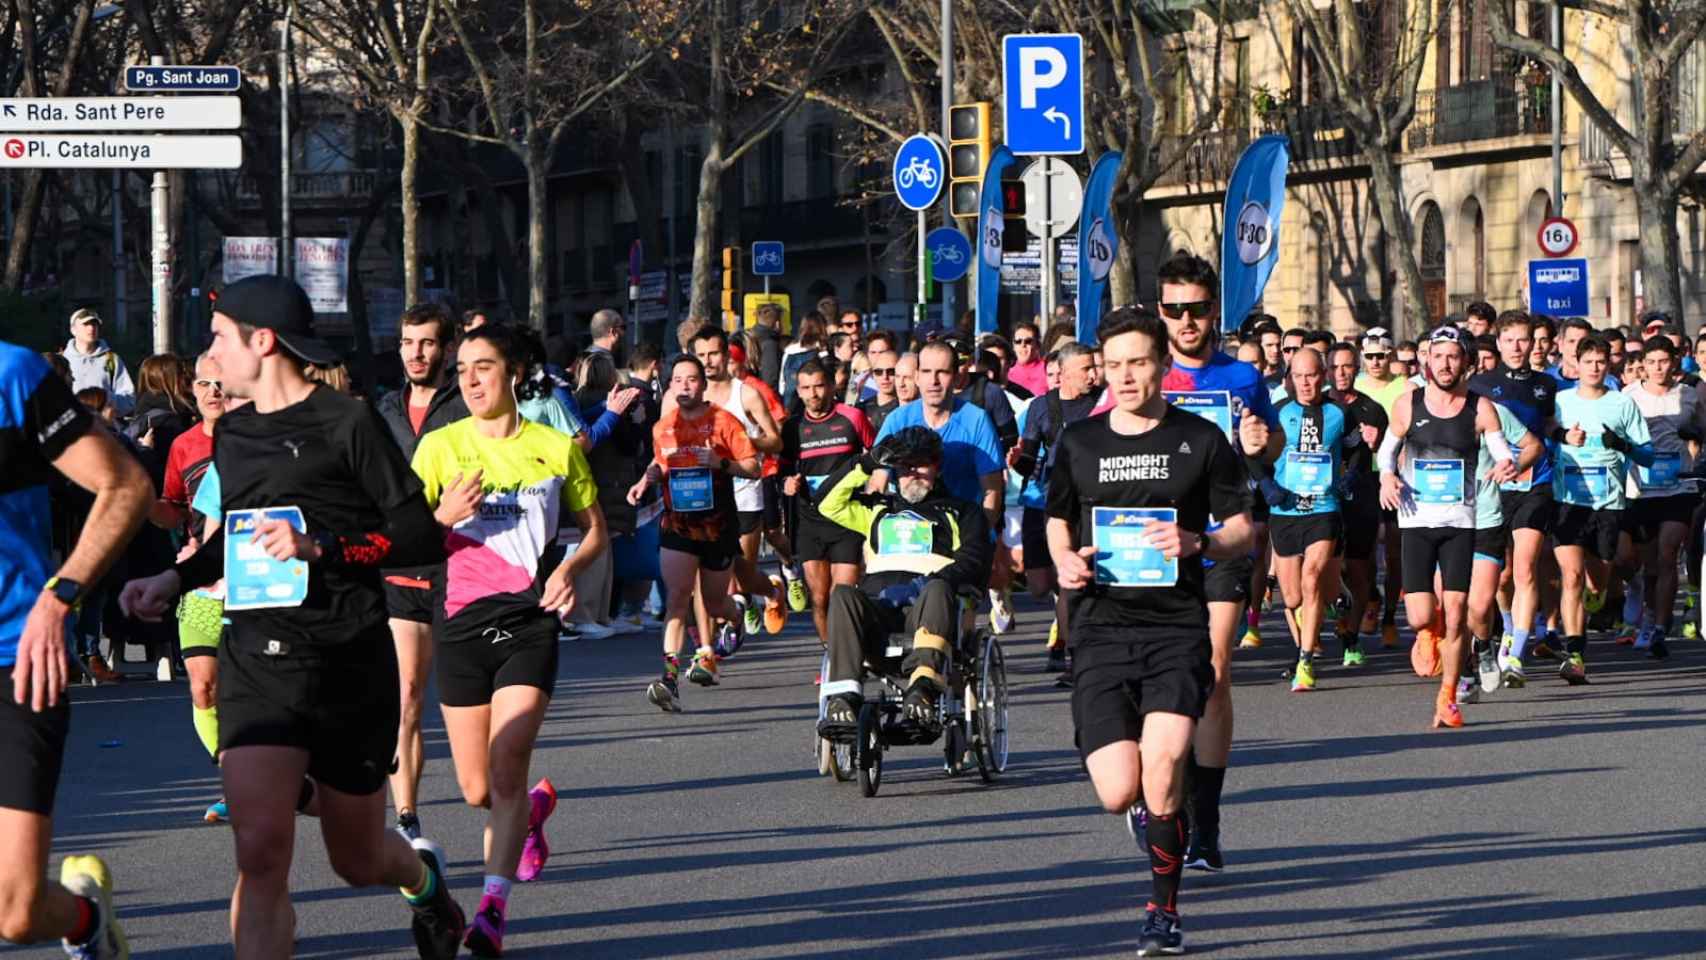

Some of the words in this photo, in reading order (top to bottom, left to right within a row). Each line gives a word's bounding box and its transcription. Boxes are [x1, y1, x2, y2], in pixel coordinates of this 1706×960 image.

[136, 71, 158, 86] Pg.
[162, 71, 193, 84] Sant
[196, 71, 229, 84] Joan
[1019, 46, 1067, 109] P
[27, 103, 68, 121] Rda.
[75, 103, 117, 120] Sant
[124, 103, 165, 120] Pere
[28, 141, 51, 158] Pl.
[58, 141, 151, 161] Catalunya
[1547, 296, 1571, 310] taxi
[1302, 417, 1314, 427] IN
[1302, 426, 1319, 435] DO
[1301, 435, 1320, 444] MA
[1099, 454, 1170, 470] MIDNIGHT
[1098, 466, 1170, 483] RUNNERS
